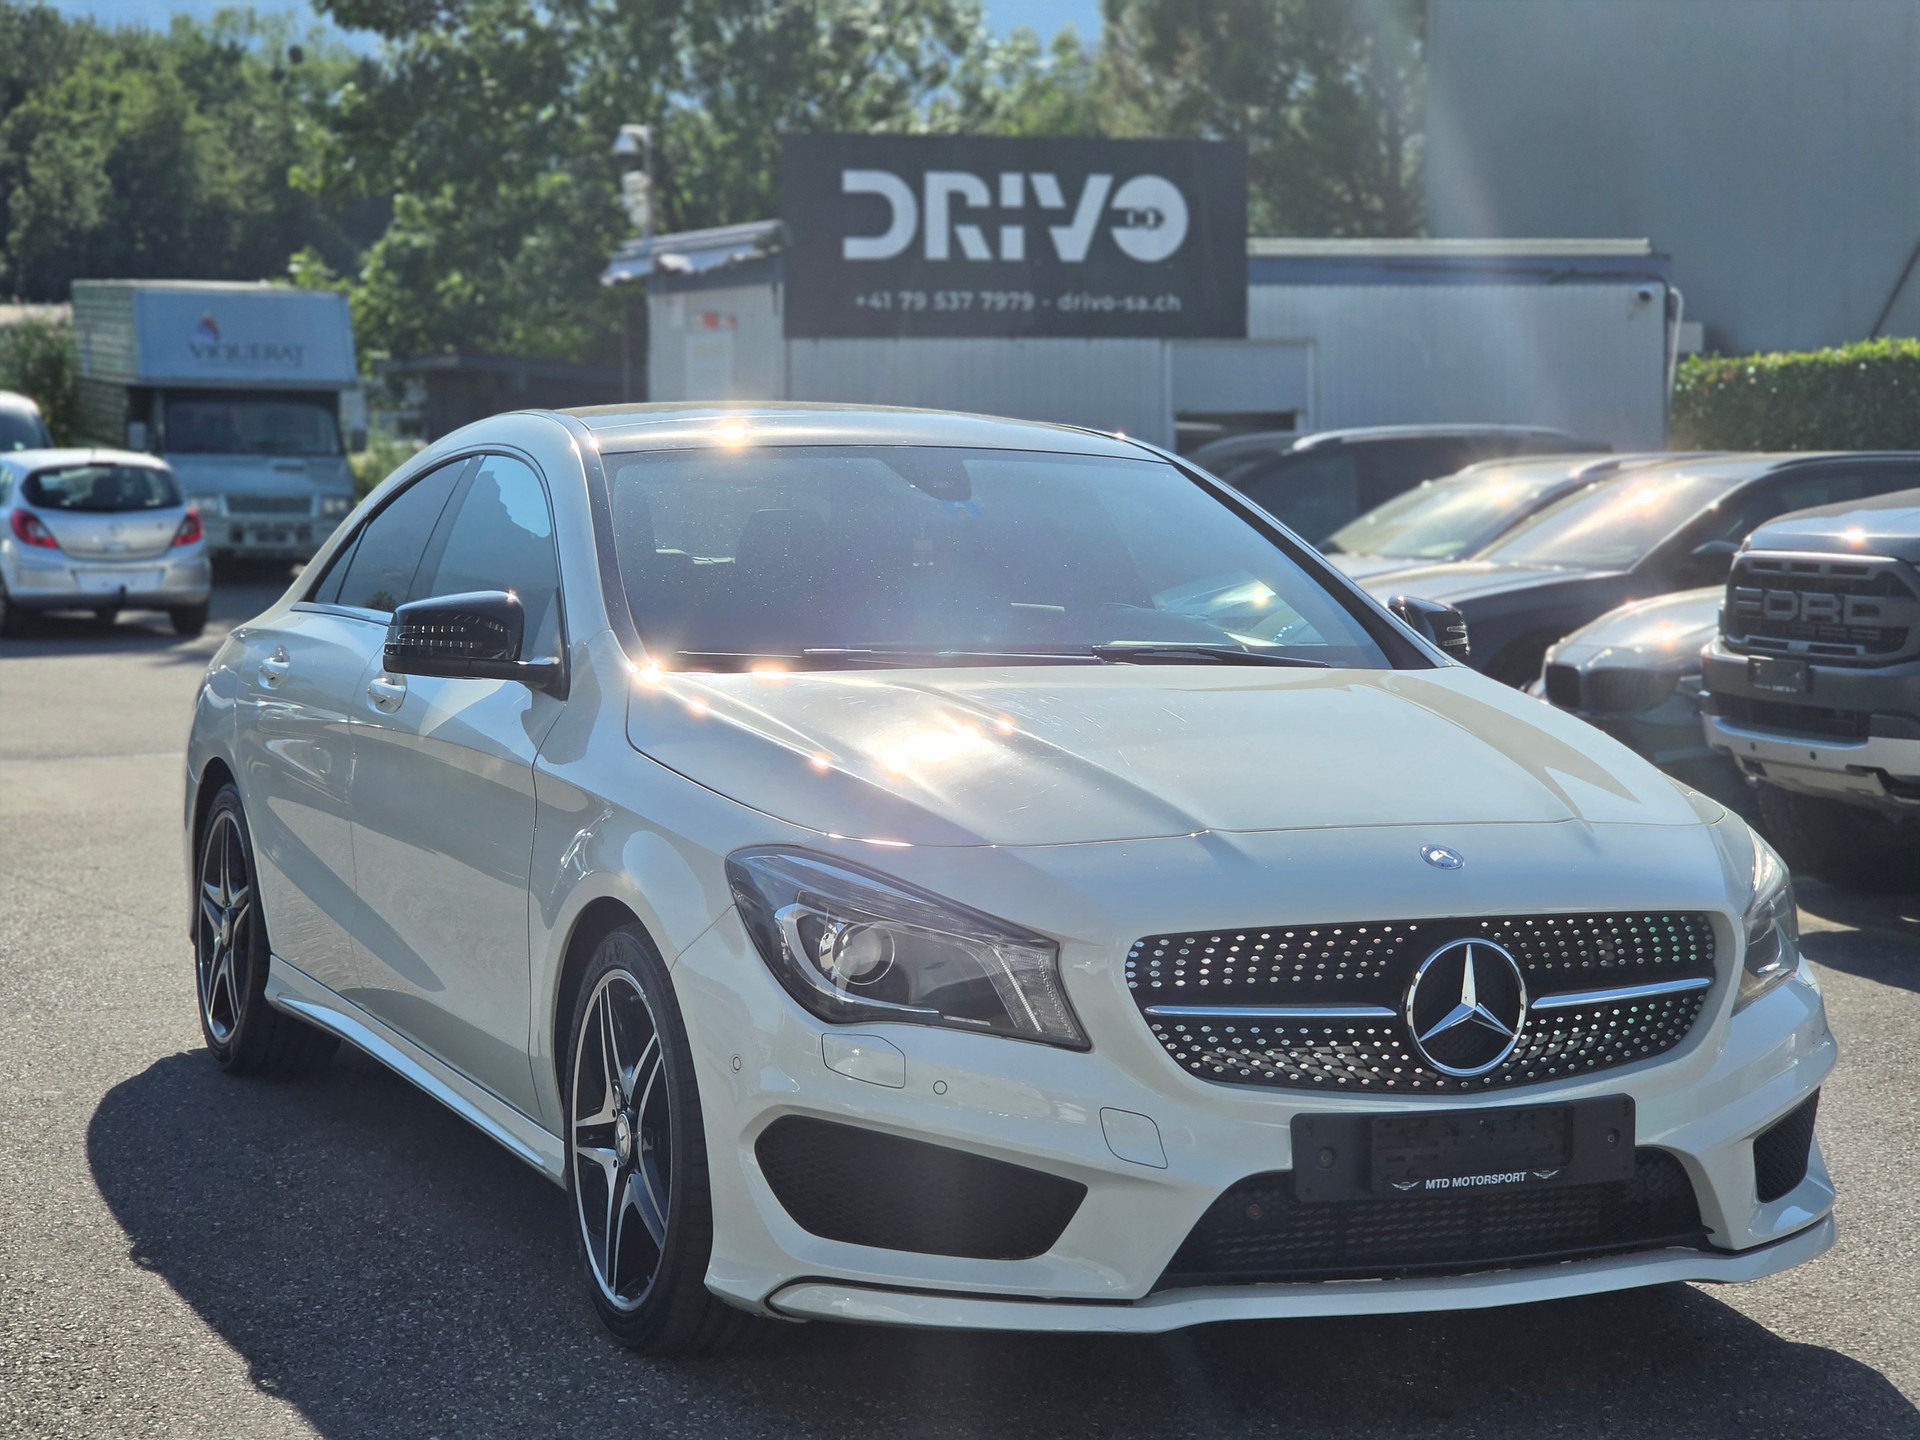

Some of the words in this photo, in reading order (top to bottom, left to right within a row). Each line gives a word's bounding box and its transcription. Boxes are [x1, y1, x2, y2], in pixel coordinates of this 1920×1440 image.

[841, 168, 1189, 263] DRIVO
[855, 291, 892, 311] +41
[899, 291, 928, 311] 79
[934, 291, 974, 311] 537
[980, 291, 1036, 311] 7979
[1056, 291, 1182, 313] drivo-sa.ch
[1735, 585, 1888, 626] FORD
[1425, 1178, 1450, 1190] MTD
[1452, 1171, 1527, 1188] MOTORSPORT
